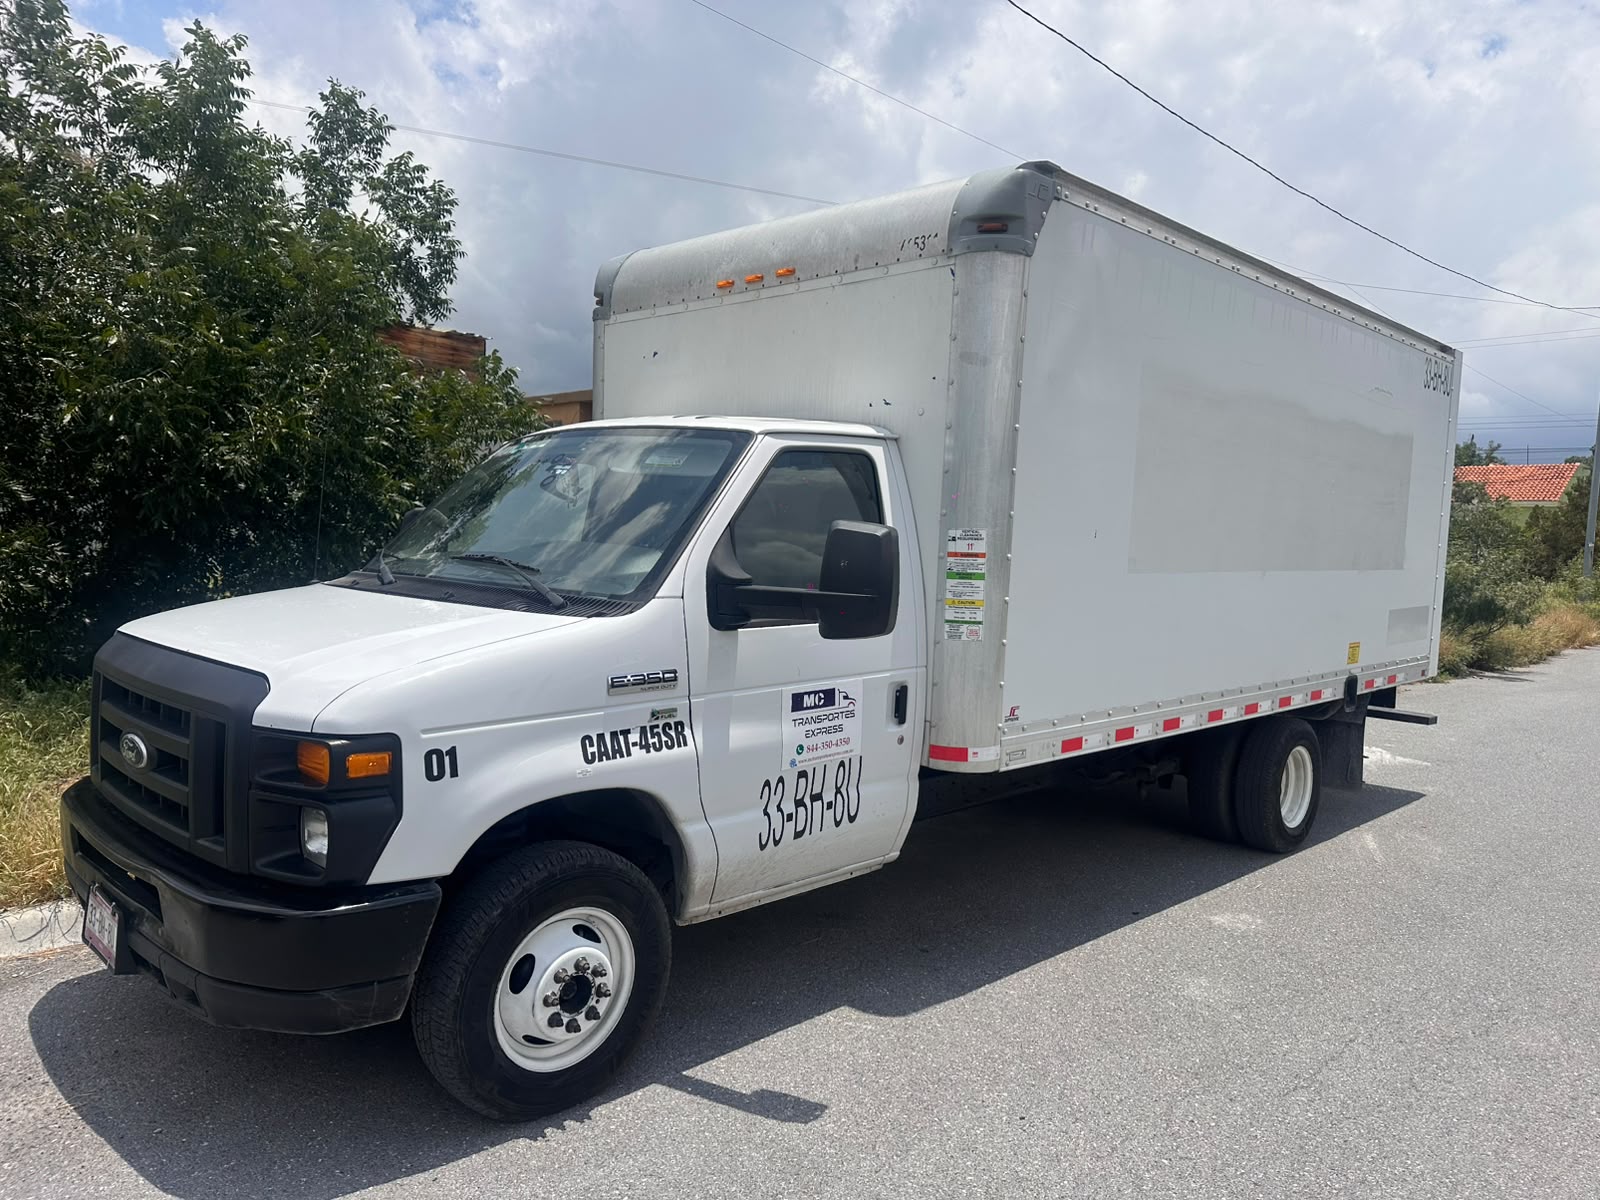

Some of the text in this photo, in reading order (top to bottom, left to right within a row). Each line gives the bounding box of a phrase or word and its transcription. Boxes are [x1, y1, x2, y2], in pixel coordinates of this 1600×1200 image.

[803, 692, 825, 708] MC
[792, 709, 856, 728] TRANSPORTES
[804, 723, 844, 739] EXPRESS
[580, 720, 689, 765] CAAT-45SR
[805, 736, 851, 754] 844-350-4350
[423, 745, 460, 782] 01
[758, 755, 863, 851] 33-BH-8U
